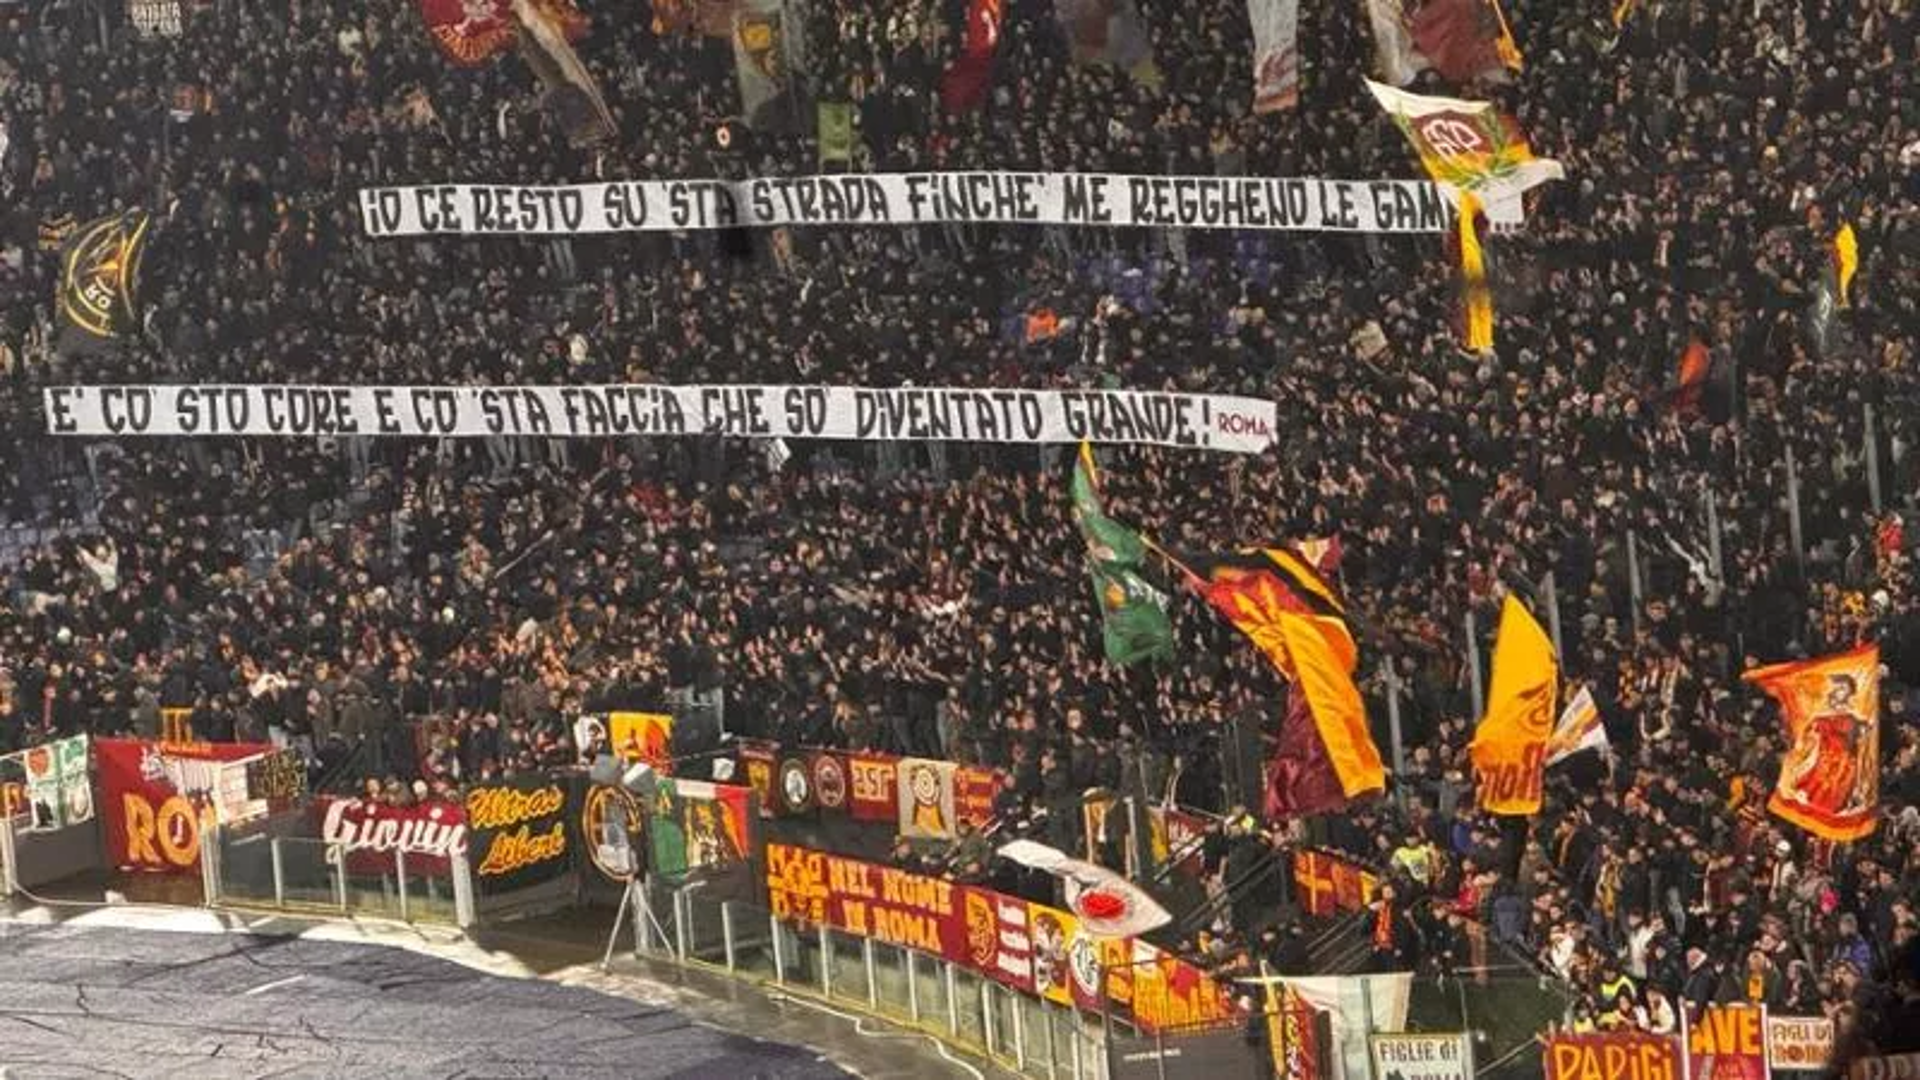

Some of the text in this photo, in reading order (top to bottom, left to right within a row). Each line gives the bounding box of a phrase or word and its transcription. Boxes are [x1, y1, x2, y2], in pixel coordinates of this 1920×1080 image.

[415, 187, 461, 231] CE
[470, 186, 584, 231] RESTO
[604, 183, 648, 228] SU
[752, 175, 890, 222] STRADA
[1063, 174, 1112, 222] ME
[1128, 177, 1308, 226] REGGHENO
[1318, 181, 1359, 228] LE
[175, 387, 250, 432] STO
[261, 388, 359, 433] CORE
[374, 388, 400, 433] E
[701, 387, 770, 434] CHE
[827, 855, 876, 898] NEL
[882, 867, 953, 916] NOME
[873, 906, 943, 954] ROMA
